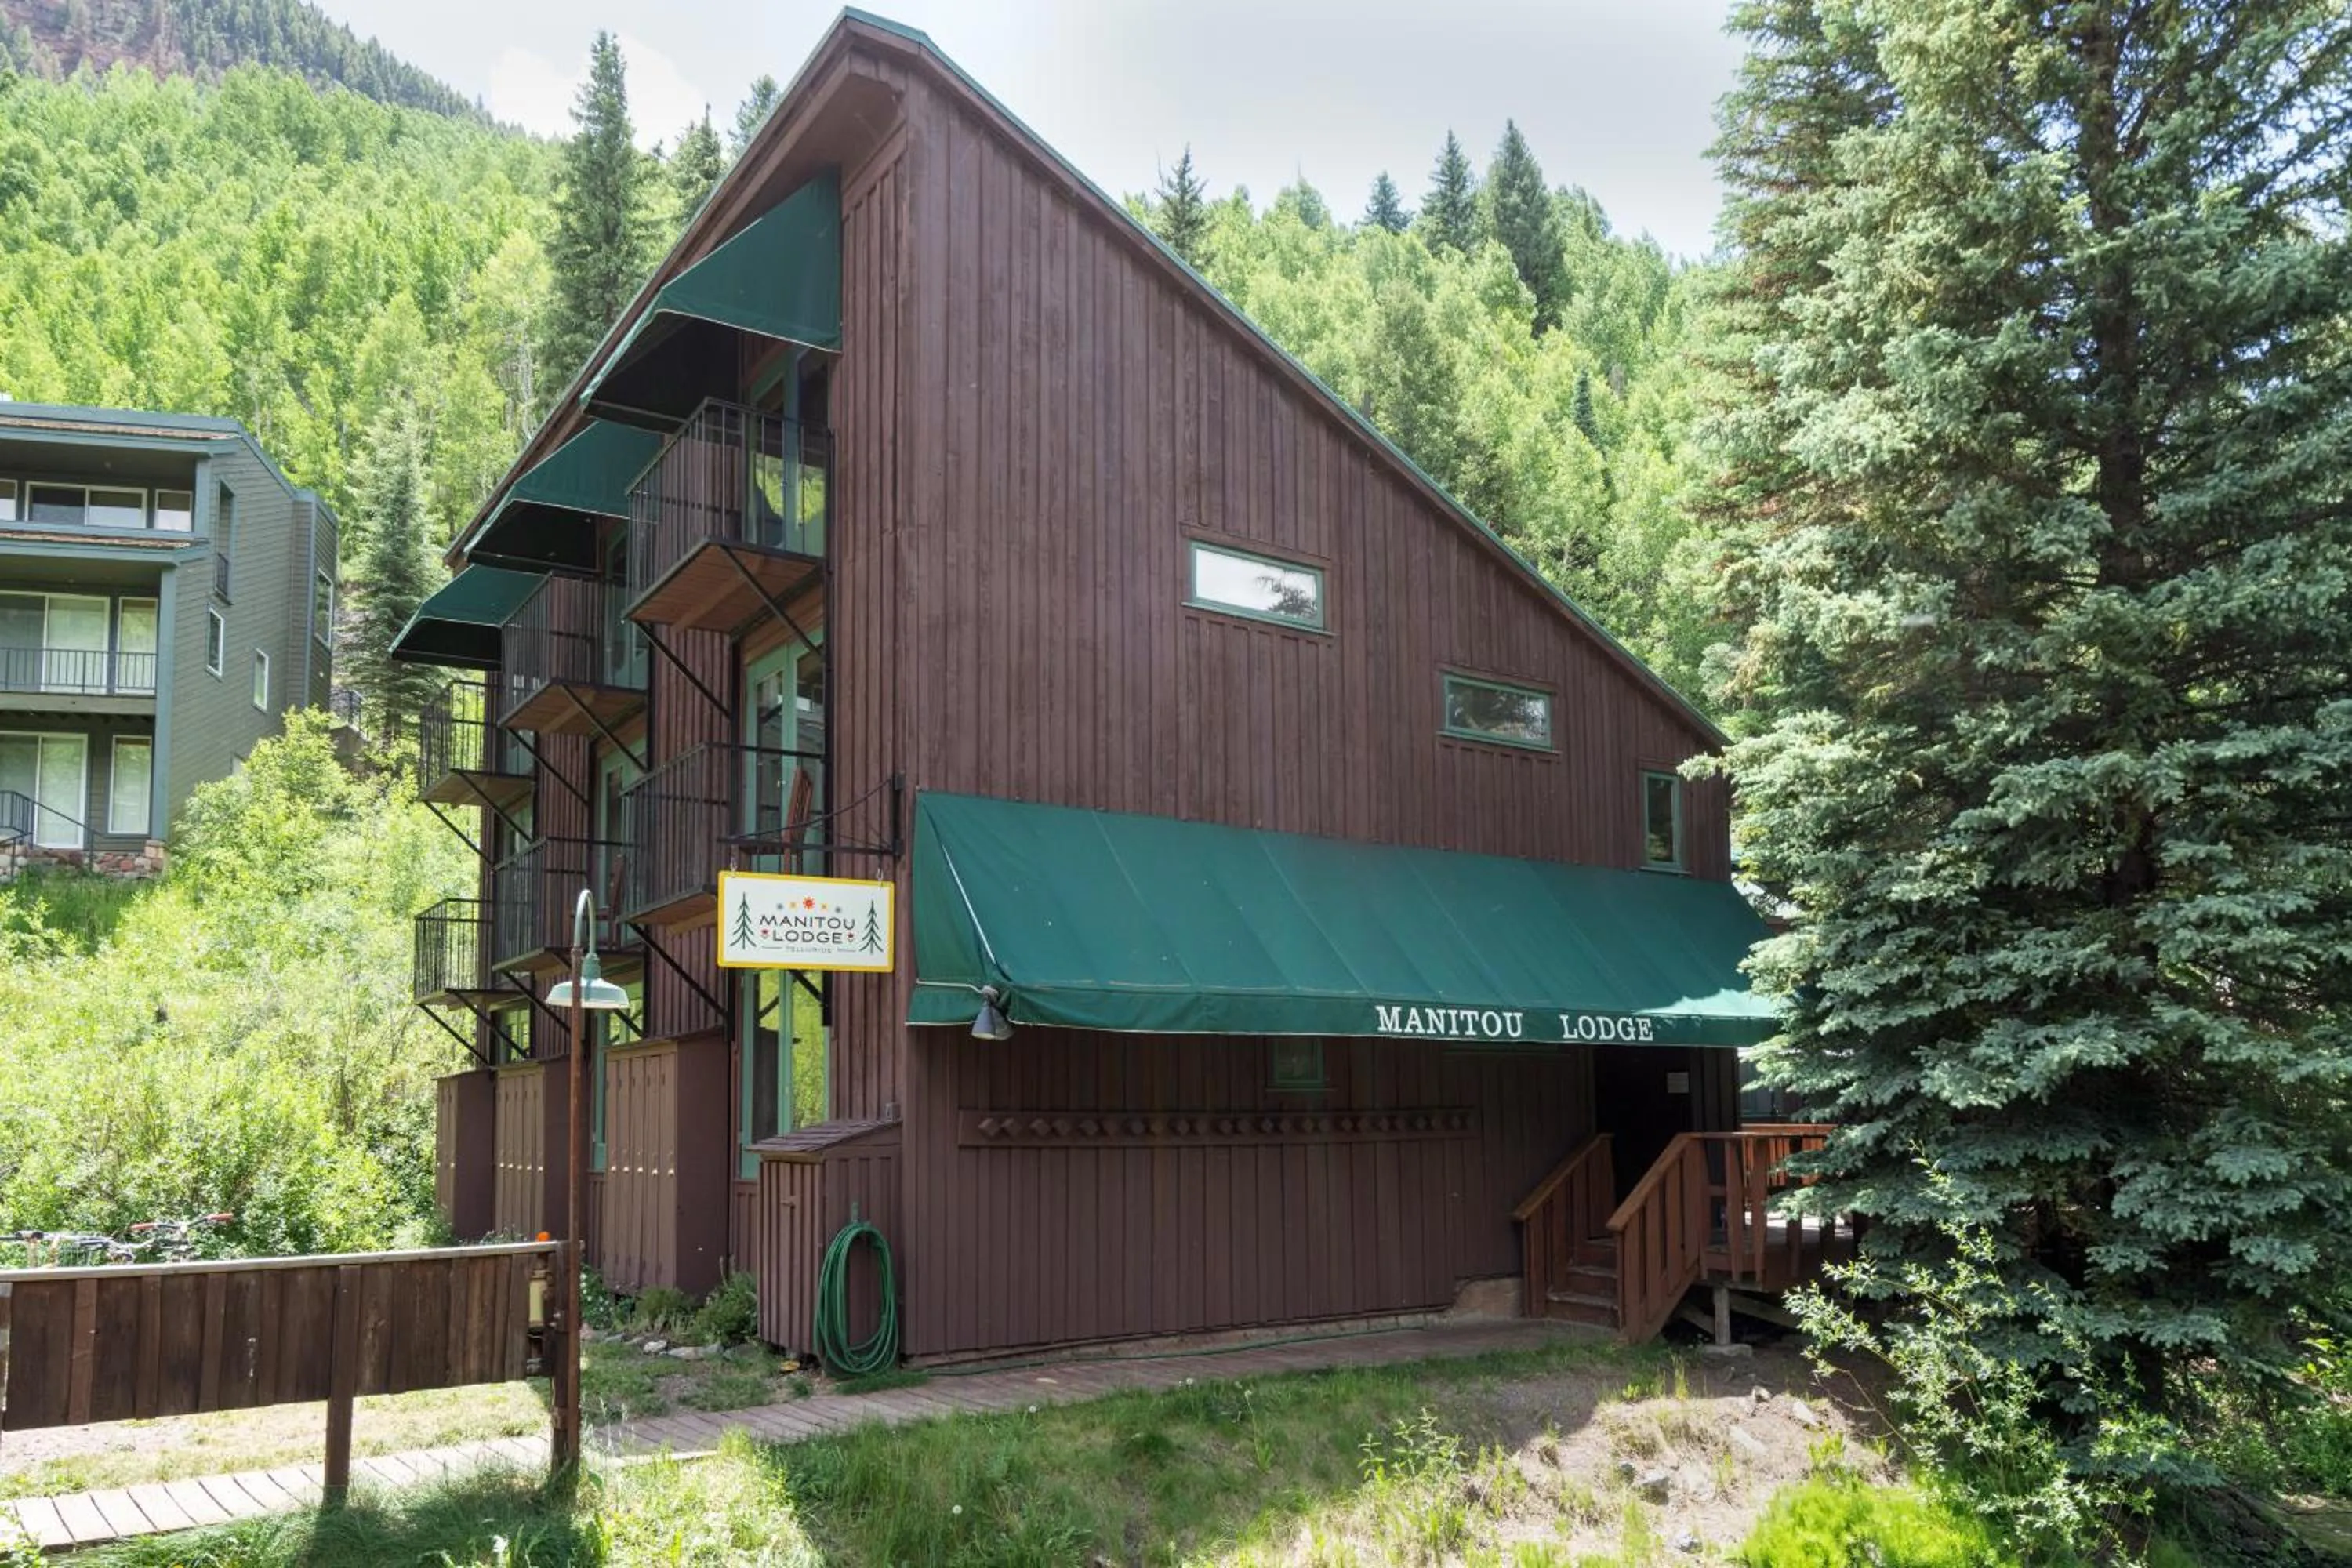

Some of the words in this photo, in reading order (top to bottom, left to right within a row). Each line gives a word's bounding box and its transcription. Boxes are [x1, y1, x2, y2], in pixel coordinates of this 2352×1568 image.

[760, 915, 855, 930] MANITOU
[772, 930, 843, 944] LODGE
[1375, 1005, 1523, 1037] MANITOU
[1559, 1014, 1653, 1041] LODGE
